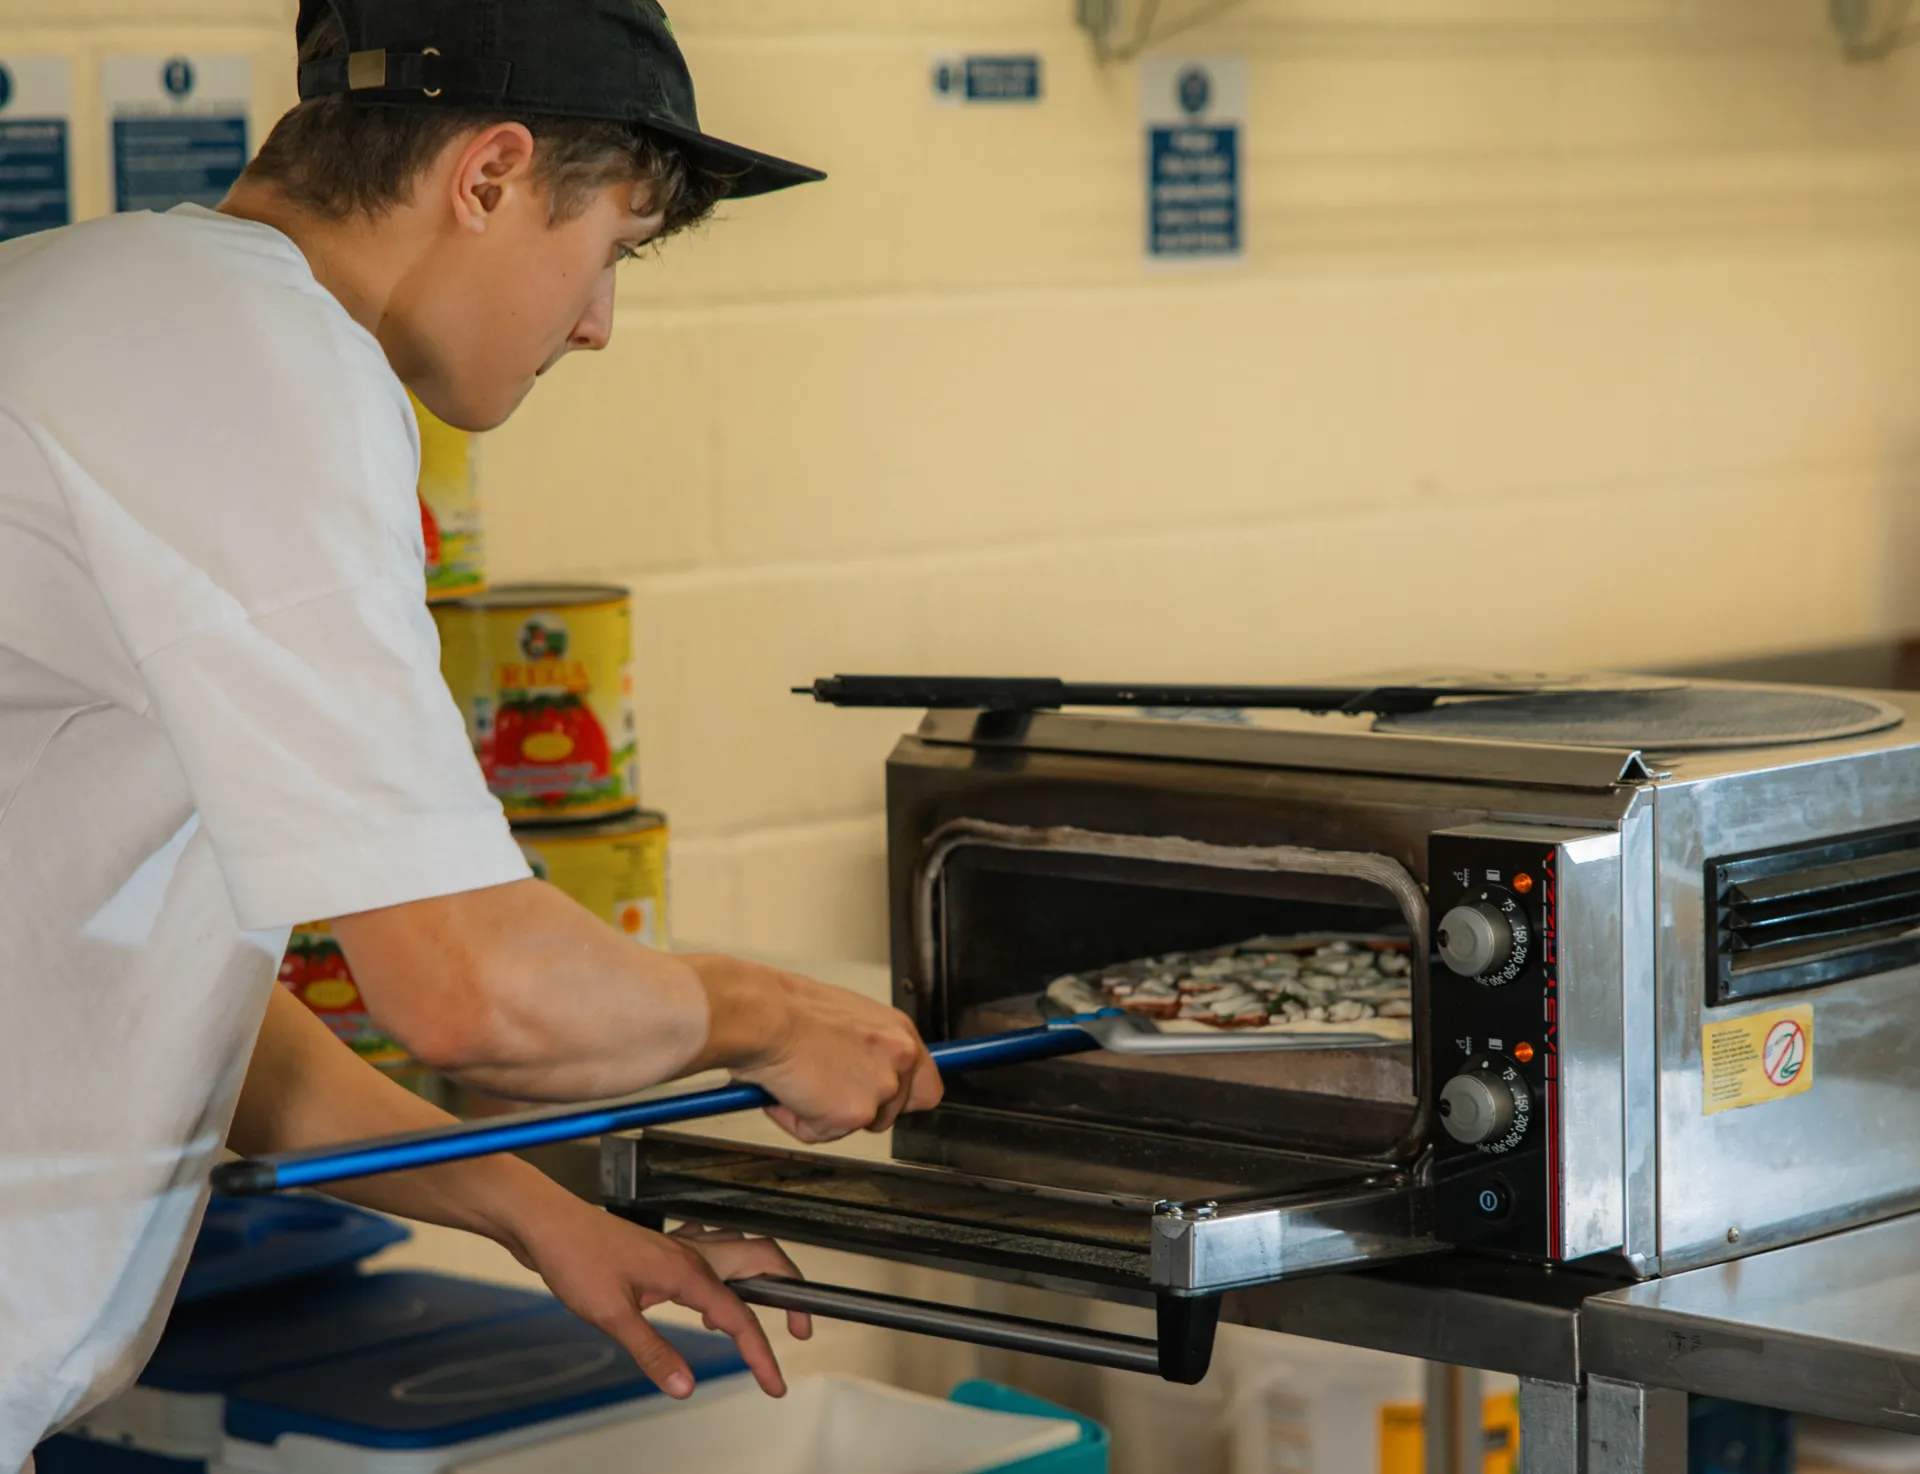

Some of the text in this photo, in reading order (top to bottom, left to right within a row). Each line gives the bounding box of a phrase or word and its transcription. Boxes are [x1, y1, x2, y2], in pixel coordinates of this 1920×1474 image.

[1504, 898, 1516, 912] 75
[1515, 924, 1528, 943] 150
[1513, 945, 1527, 964] 200
[1503, 963, 1520, 980] 250
[1542, 850, 1556, 1078] EASY PIZZA
[1503, 1067, 1517, 1080] 75
[1516, 1093, 1529, 1112] 150
[1515, 1115, 1529, 1132] 200
[1505, 1131, 1522, 1147] 250
